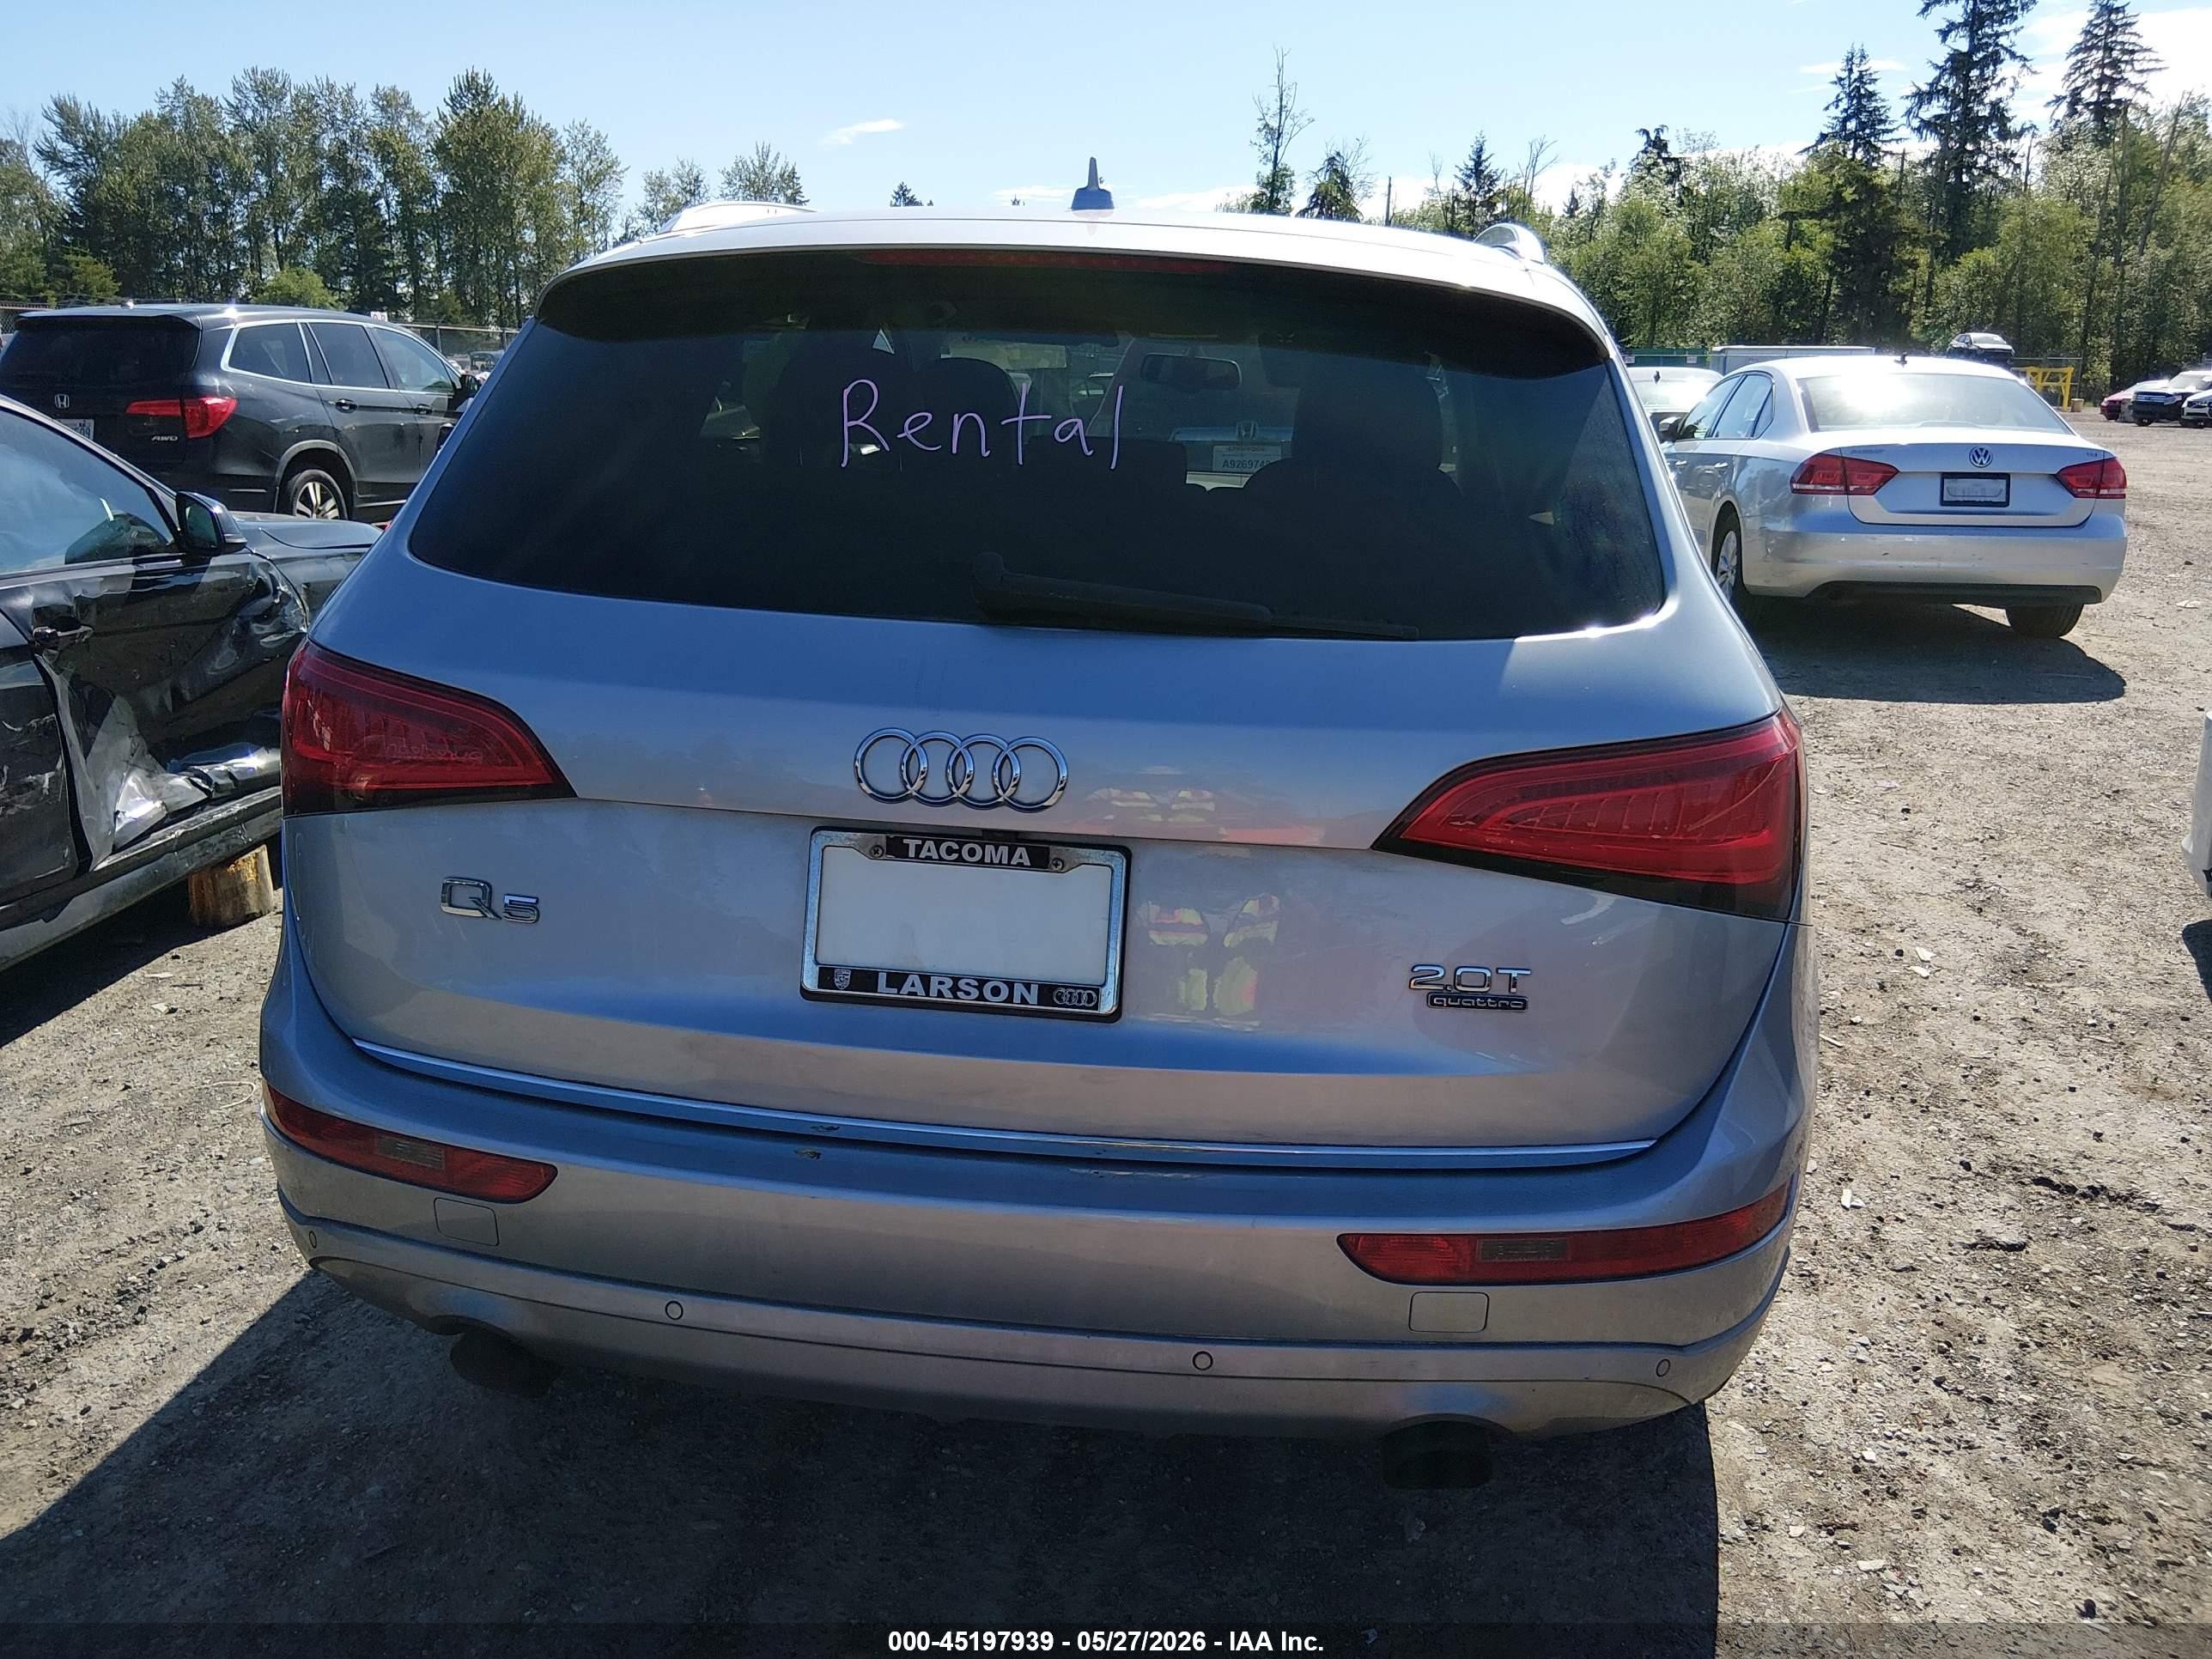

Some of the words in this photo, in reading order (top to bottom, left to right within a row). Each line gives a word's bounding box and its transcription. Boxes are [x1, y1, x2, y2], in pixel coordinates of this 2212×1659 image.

[841, 379, 1123, 470] Rental
[902, 838, 1031, 866] TACOMA
[441, 877, 539, 923] Q5
[877, 971, 1039, 1006] LARSON
[1409, 964, 1532, 994] 2.0T
[1433, 996, 1525, 1009] quattro
